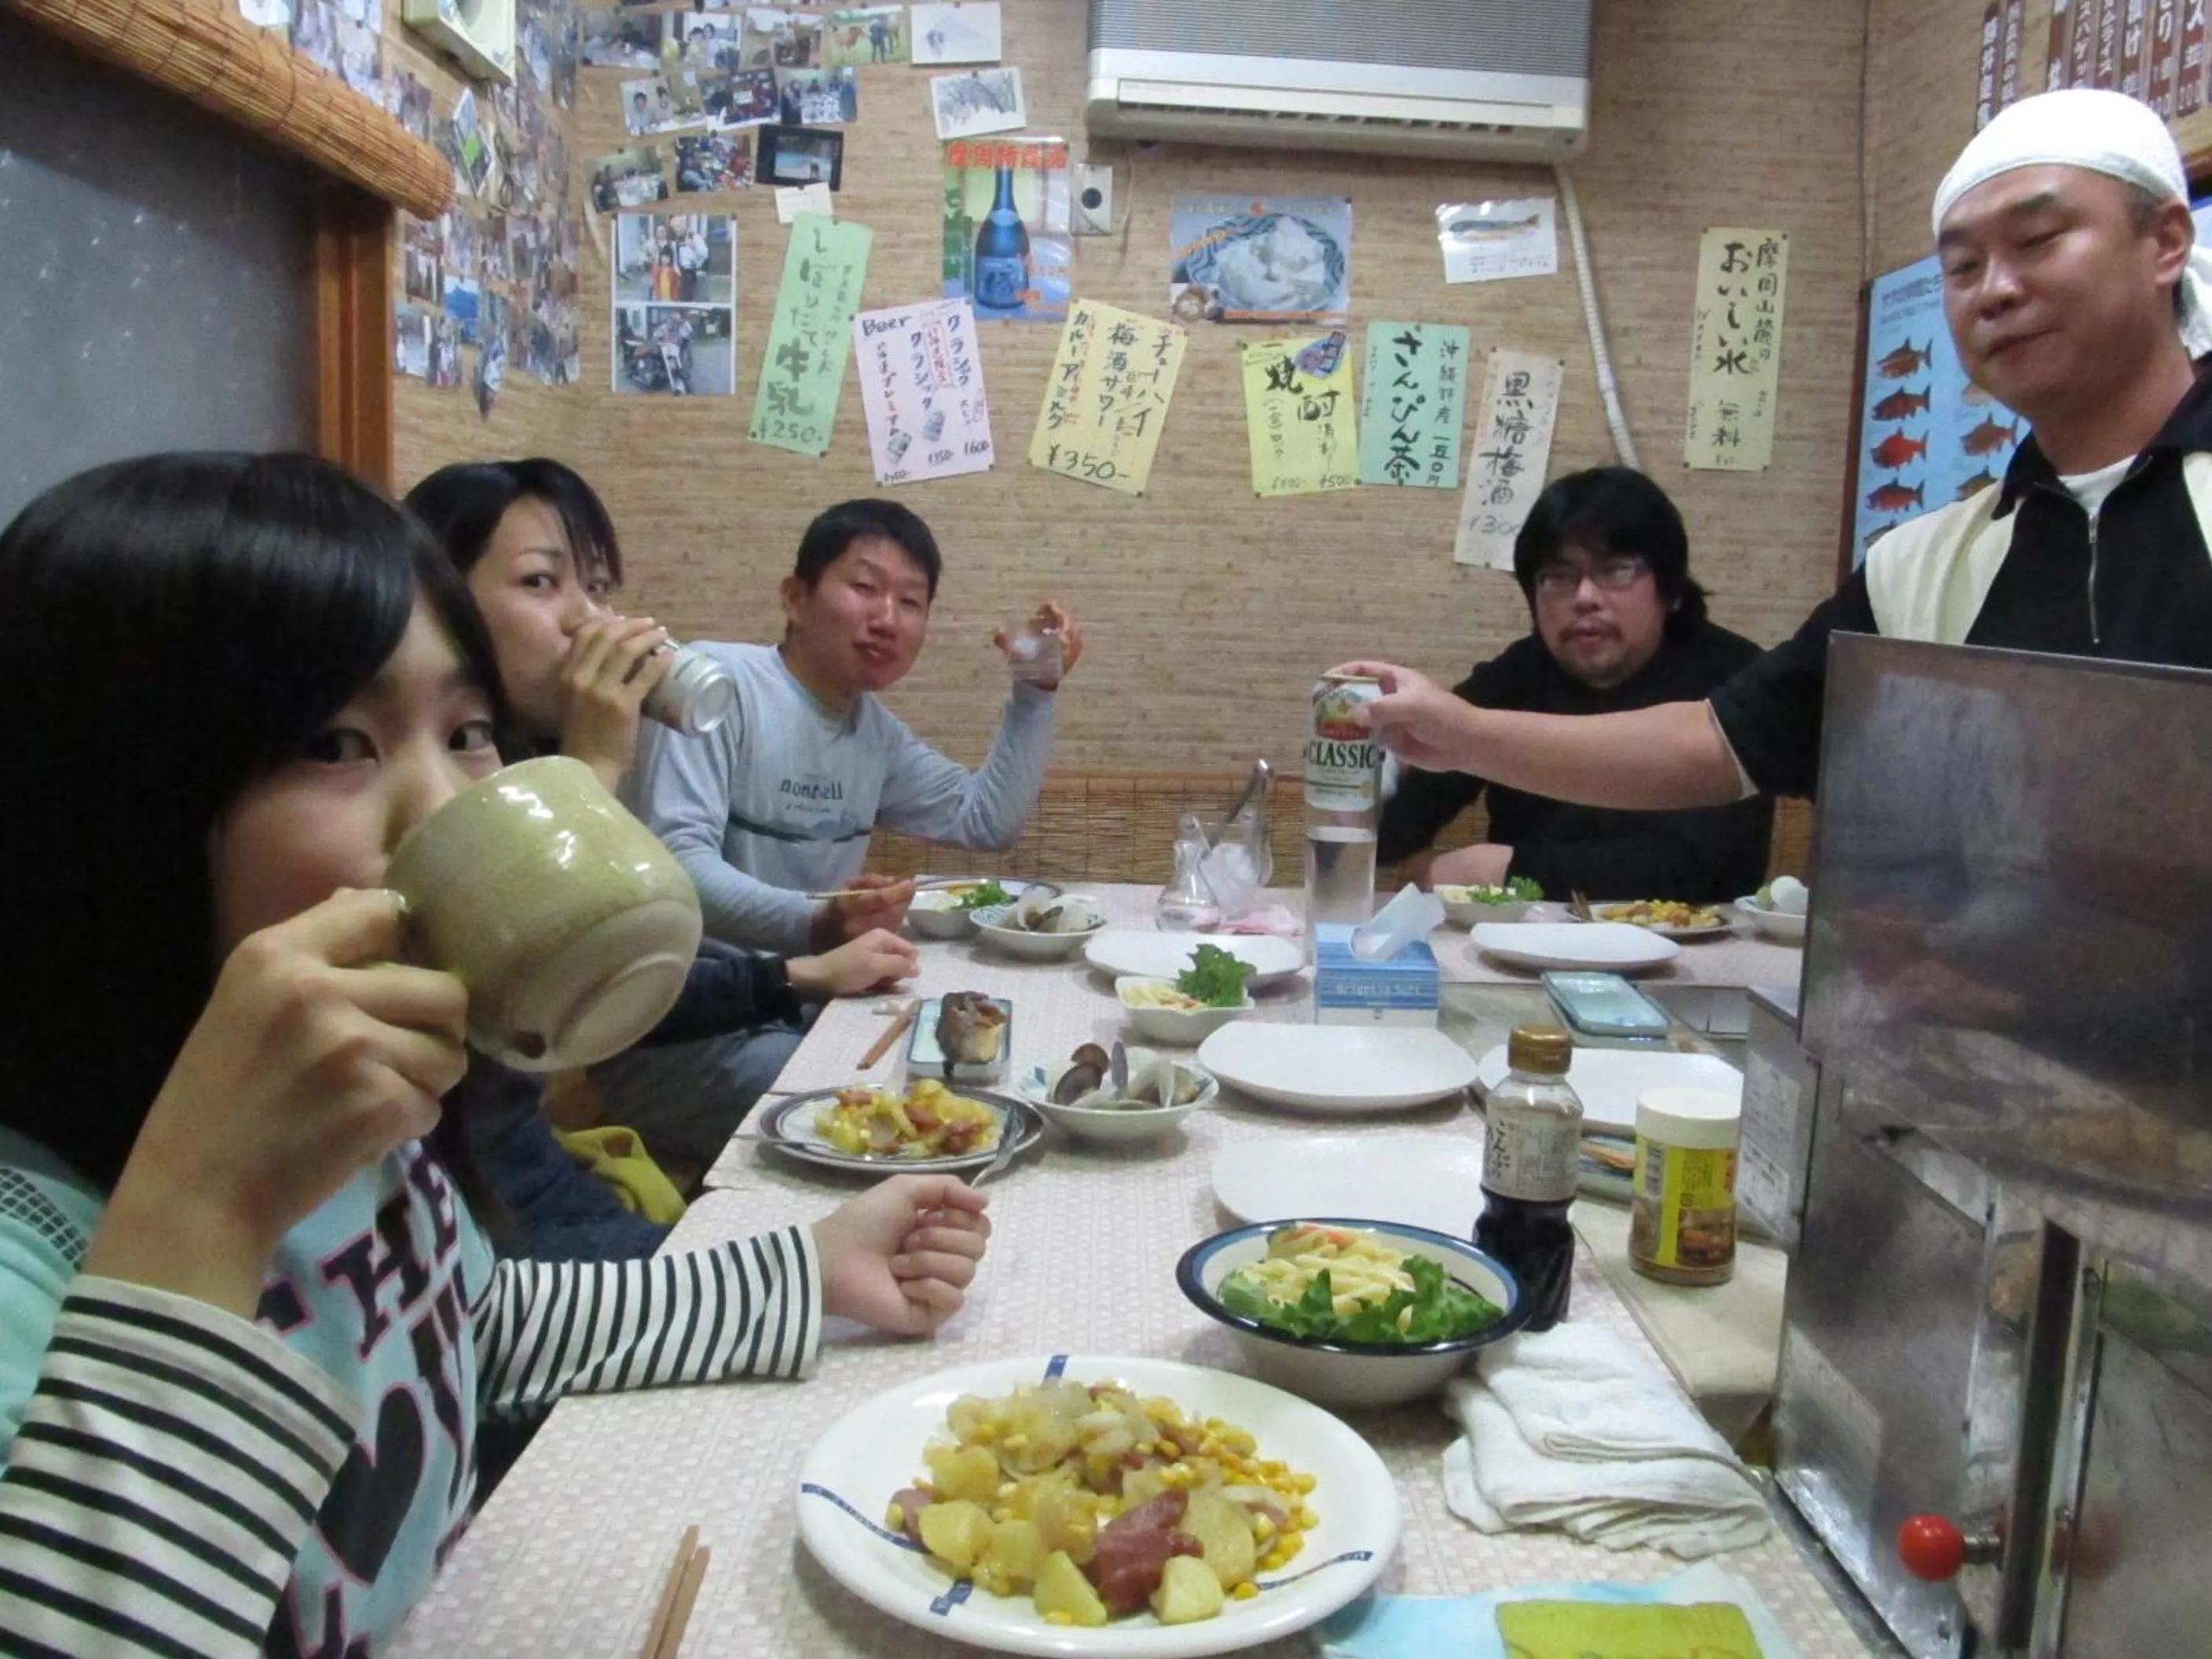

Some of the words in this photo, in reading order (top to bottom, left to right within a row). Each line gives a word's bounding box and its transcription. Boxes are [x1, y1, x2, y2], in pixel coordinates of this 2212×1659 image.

[862, 315, 912, 338] Beer
[1712, 242, 1753, 375] おいしい水
[910, 331, 932, 412] クラシック
[1098, 322, 1139, 427] 梅酒サワー
[1384, 331, 1426, 480] さんぴん茶
[1309, 740, 1377, 769] CLASSIC
